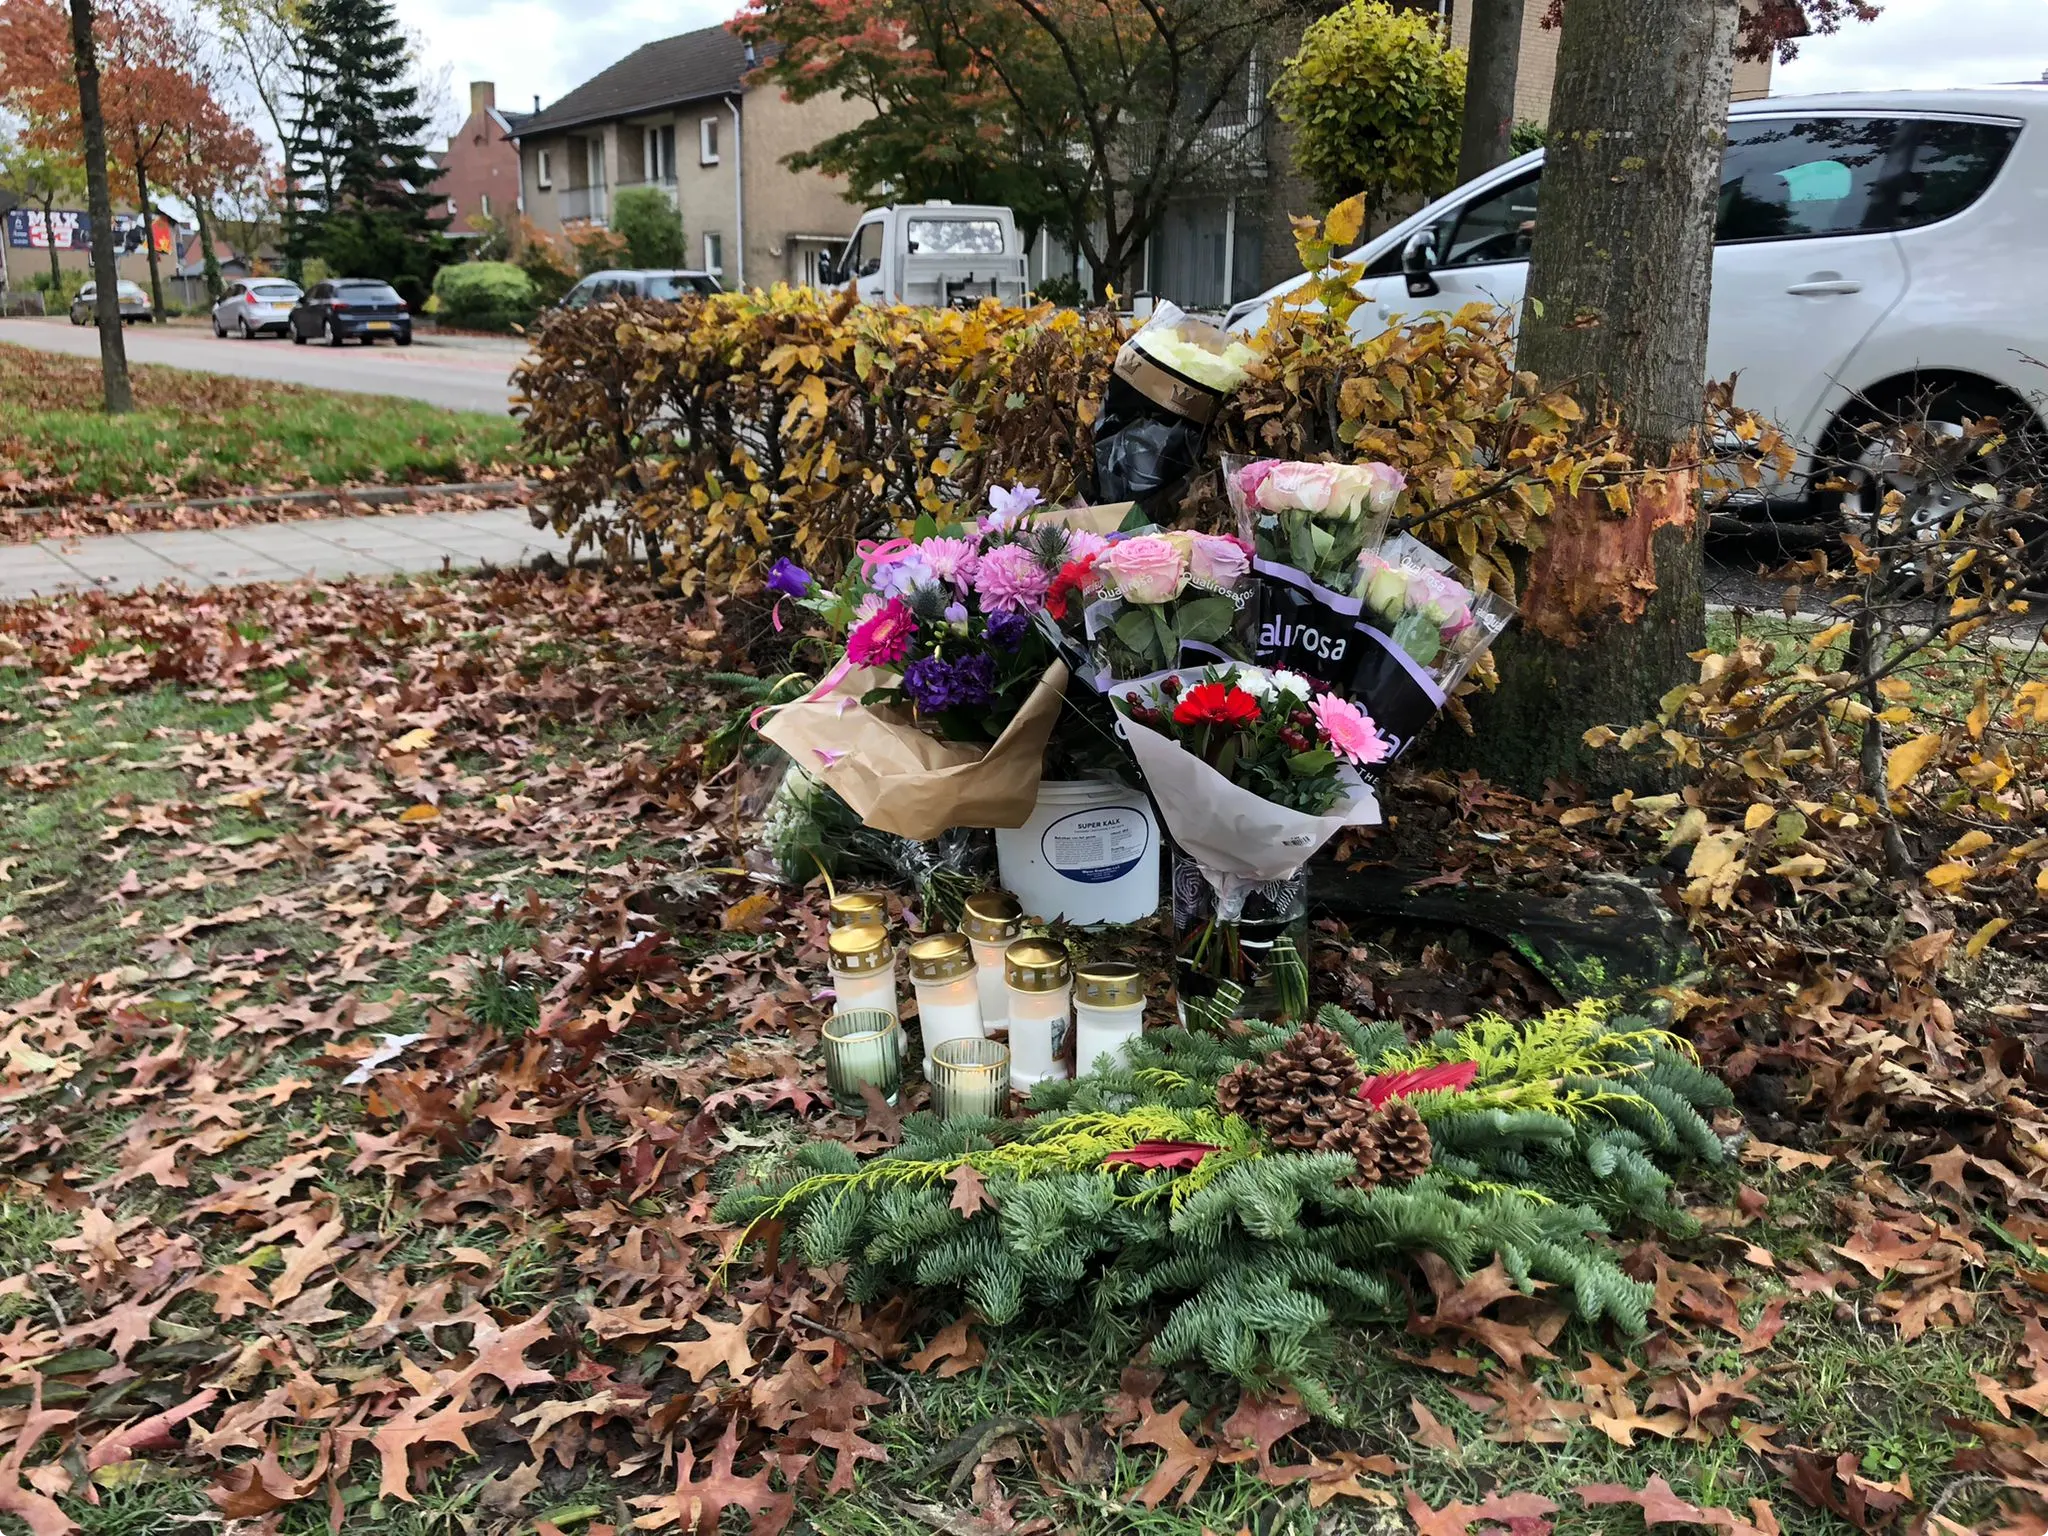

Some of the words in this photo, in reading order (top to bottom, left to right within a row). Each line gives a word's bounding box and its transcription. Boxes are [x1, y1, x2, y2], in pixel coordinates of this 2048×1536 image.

[27, 210, 80, 229] MAX
[1097, 574, 1154, 601] Qualirosa
[1258, 614, 1347, 661] alirosa
[1358, 766, 1380, 785] THE
[1077, 822, 1102, 830] SUPER
[1102, 818, 1121, 827] KALK
